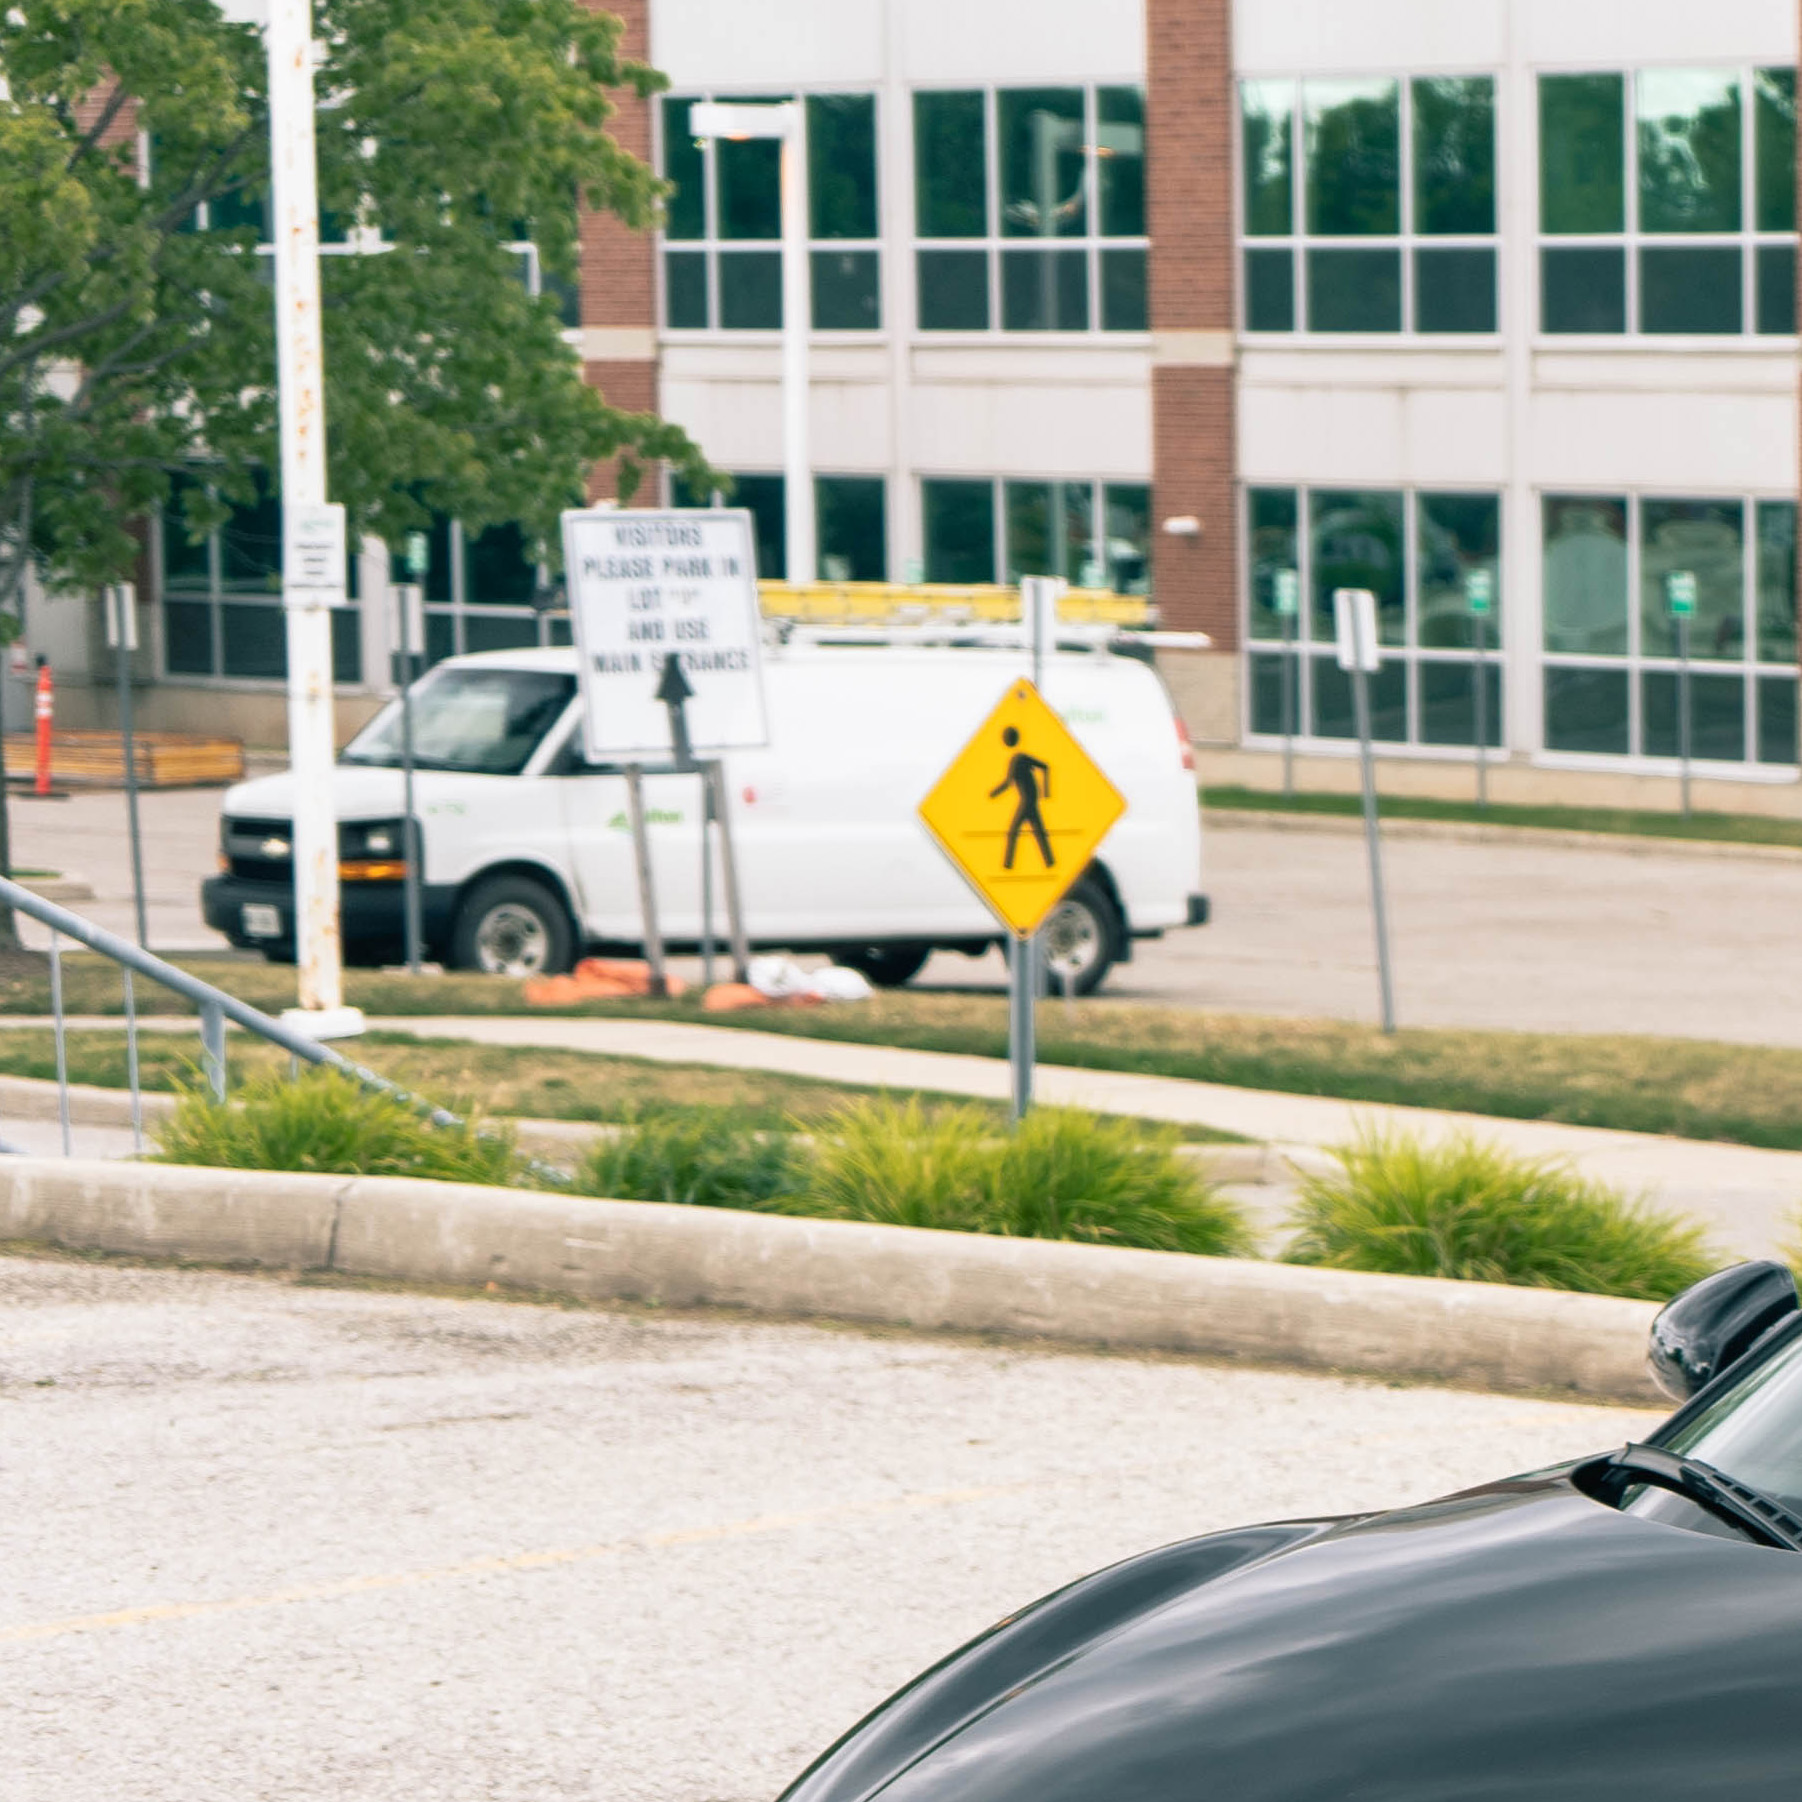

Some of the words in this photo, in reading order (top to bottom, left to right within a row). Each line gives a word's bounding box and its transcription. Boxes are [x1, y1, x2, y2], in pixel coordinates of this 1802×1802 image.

[614, 523, 702, 546] VISITORS
[583, 554, 653, 578] PLEASE
[663, 554, 713, 577] PARK
[721, 555, 741, 576] IN
[628, 586, 661, 610] LOT
[628, 618, 665, 640] AND
[675, 617, 709, 640] USE
[592, 652, 641, 673] MAIN
[651, 648, 750, 672] ERANCE
